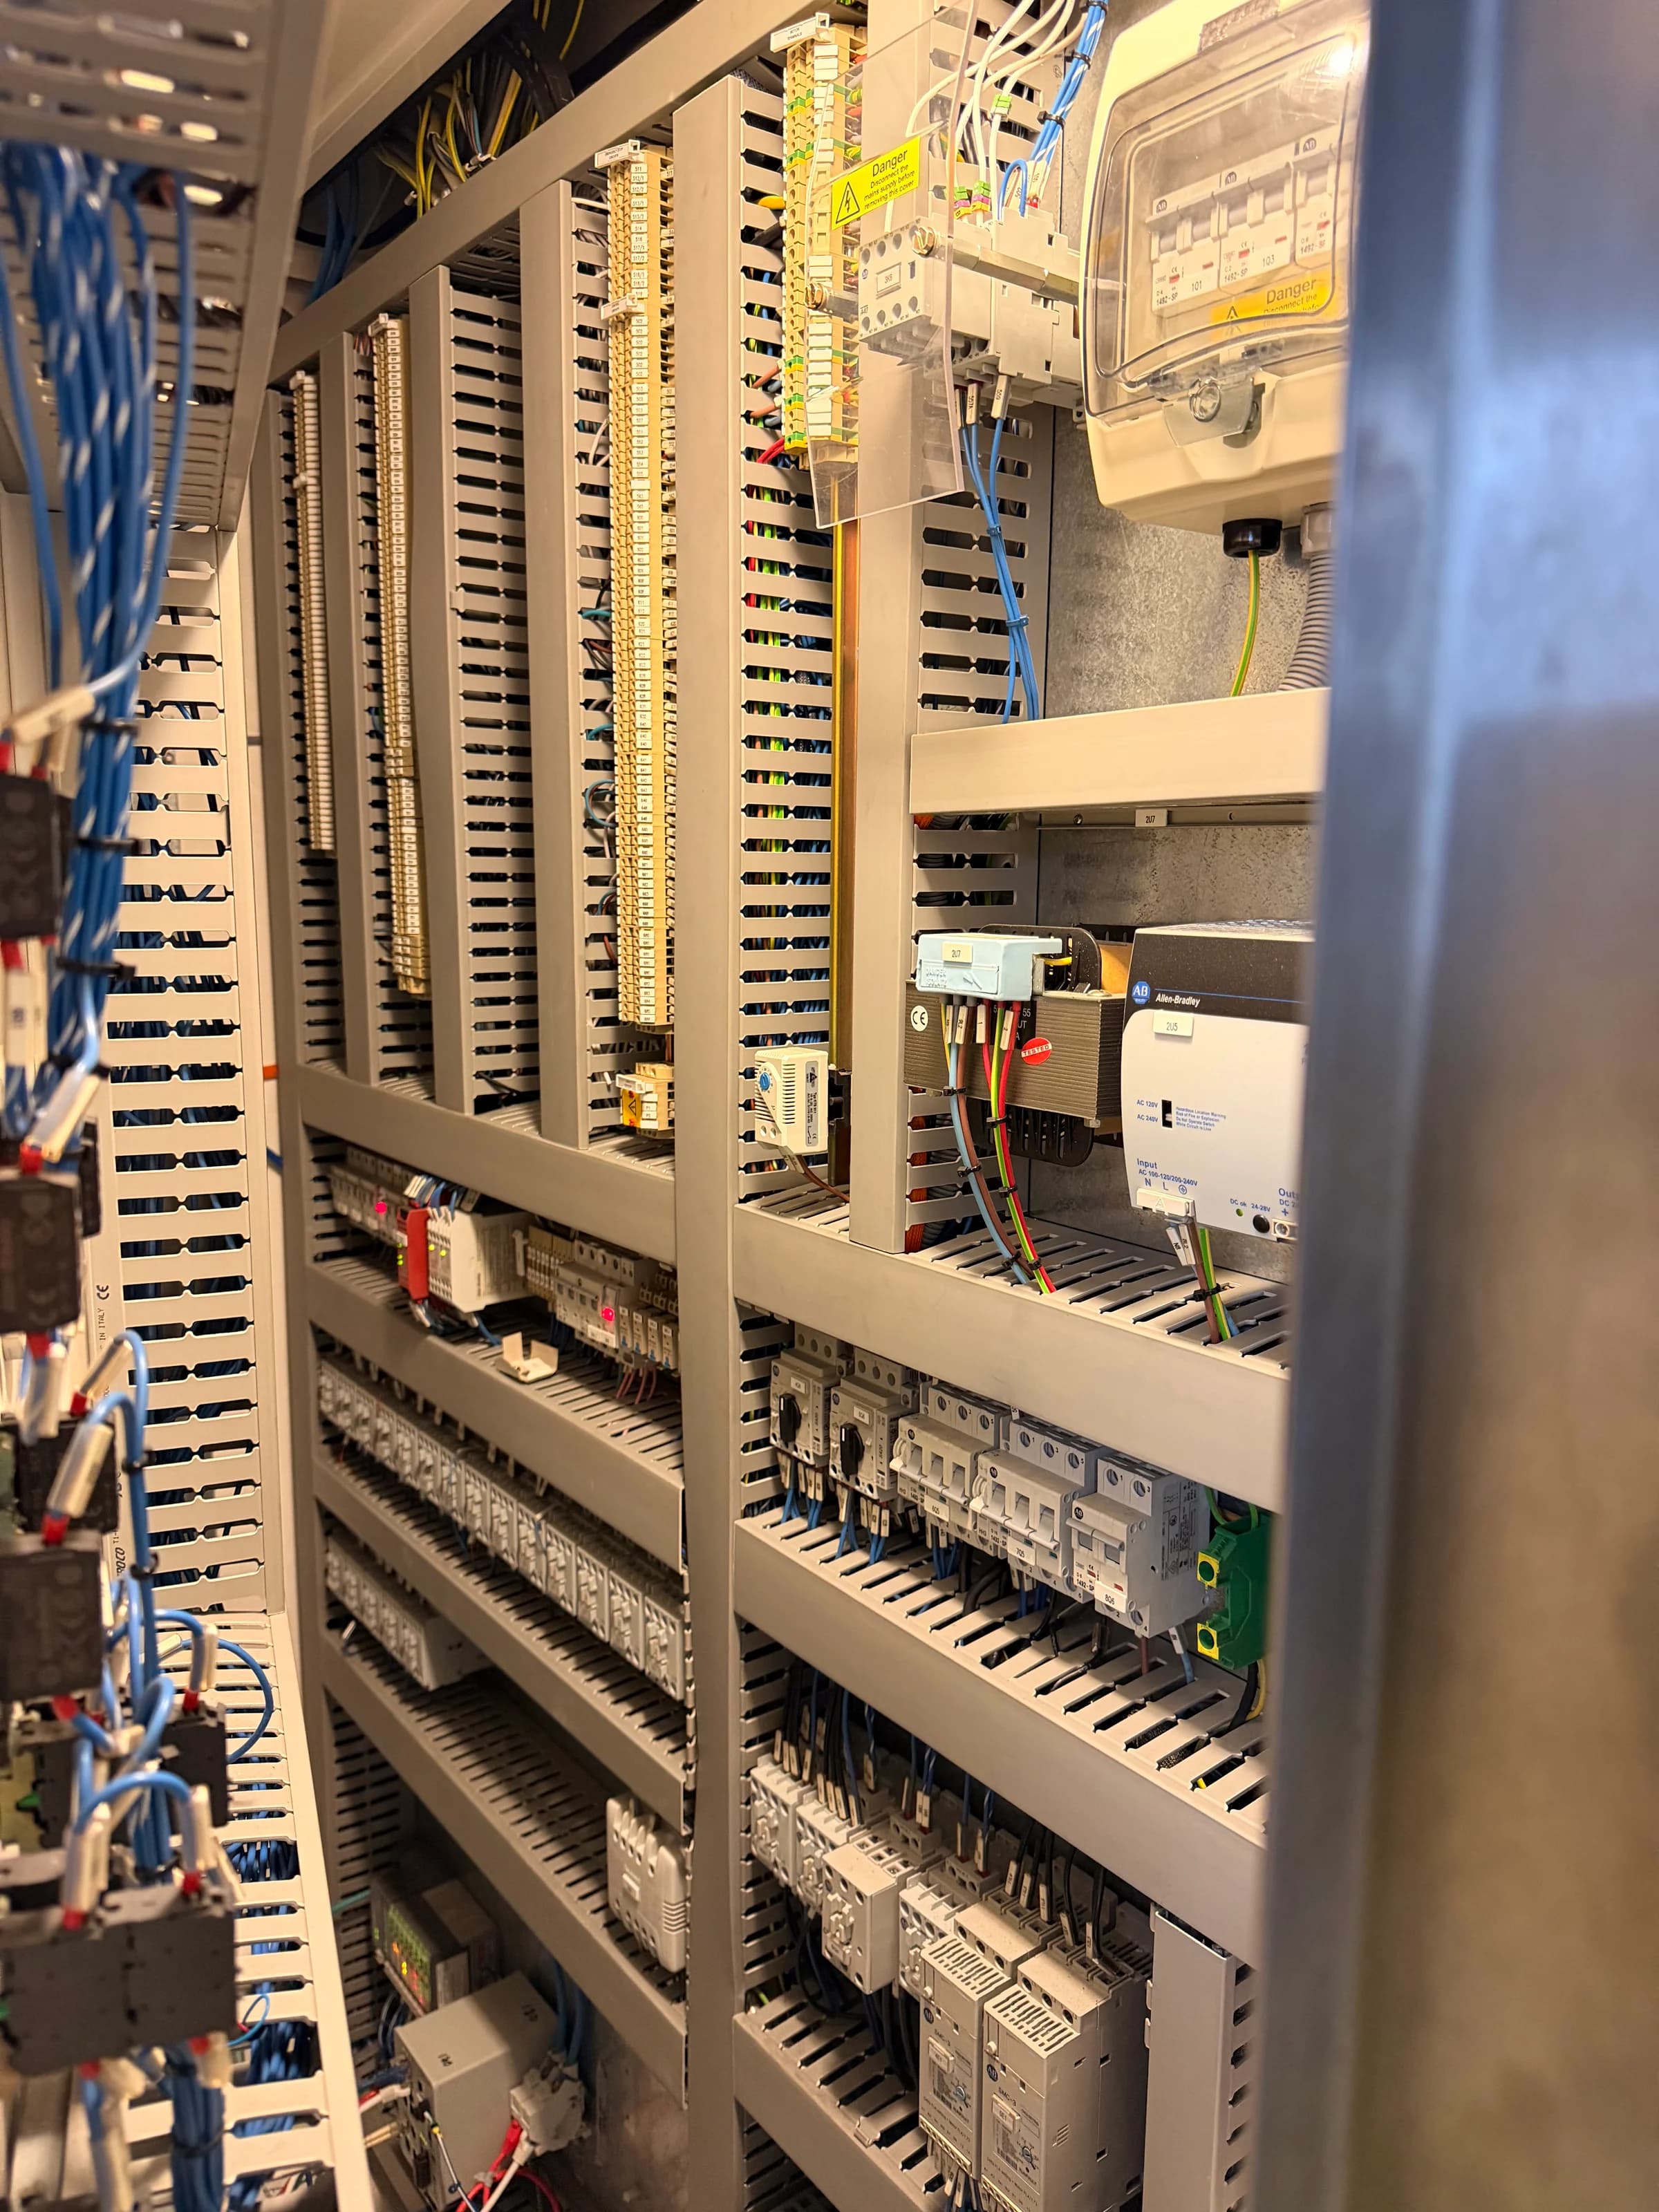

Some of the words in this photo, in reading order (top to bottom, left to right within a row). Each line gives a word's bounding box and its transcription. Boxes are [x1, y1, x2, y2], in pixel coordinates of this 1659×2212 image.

[872, 150, 907, 177] Danger
[870, 170, 899, 189] Disconnect
[900, 165, 908, 174] the
[864, 189, 879, 201] mains
[880, 181, 897, 193] supply
[898, 171, 915, 183] before
[864, 194, 888, 210] removing
[889, 188, 899, 197] this
[899, 180, 914, 191] cover
[1266, 279, 1317, 305] Danger
[1306, 292, 1318, 304] the
[1145, 815, 1156, 824] 2U7
[952, 949, 962, 958] 2U7
[1134, 985, 1148, 997] AB
[1155, 993, 1201, 1008] Allen-Bradley
[1166, 1022, 1178, 1031] 2U5
[1022, 1044, 1050, 1057] TESTED
[1137, 1158, 1158, 1170] Input
[1145, 1177, 1152, 1187] N
[1148, 1171, 1198, 1186] 100-120/200-240V
[1162, 1181, 1169, 1191] L
[1251, 1203, 1271, 1212] 24-28V
[1279, 1199, 1290, 1207] DC
[97, 1307, 106, 1329] ITALY
[99, 1333, 106, 1341] IN
